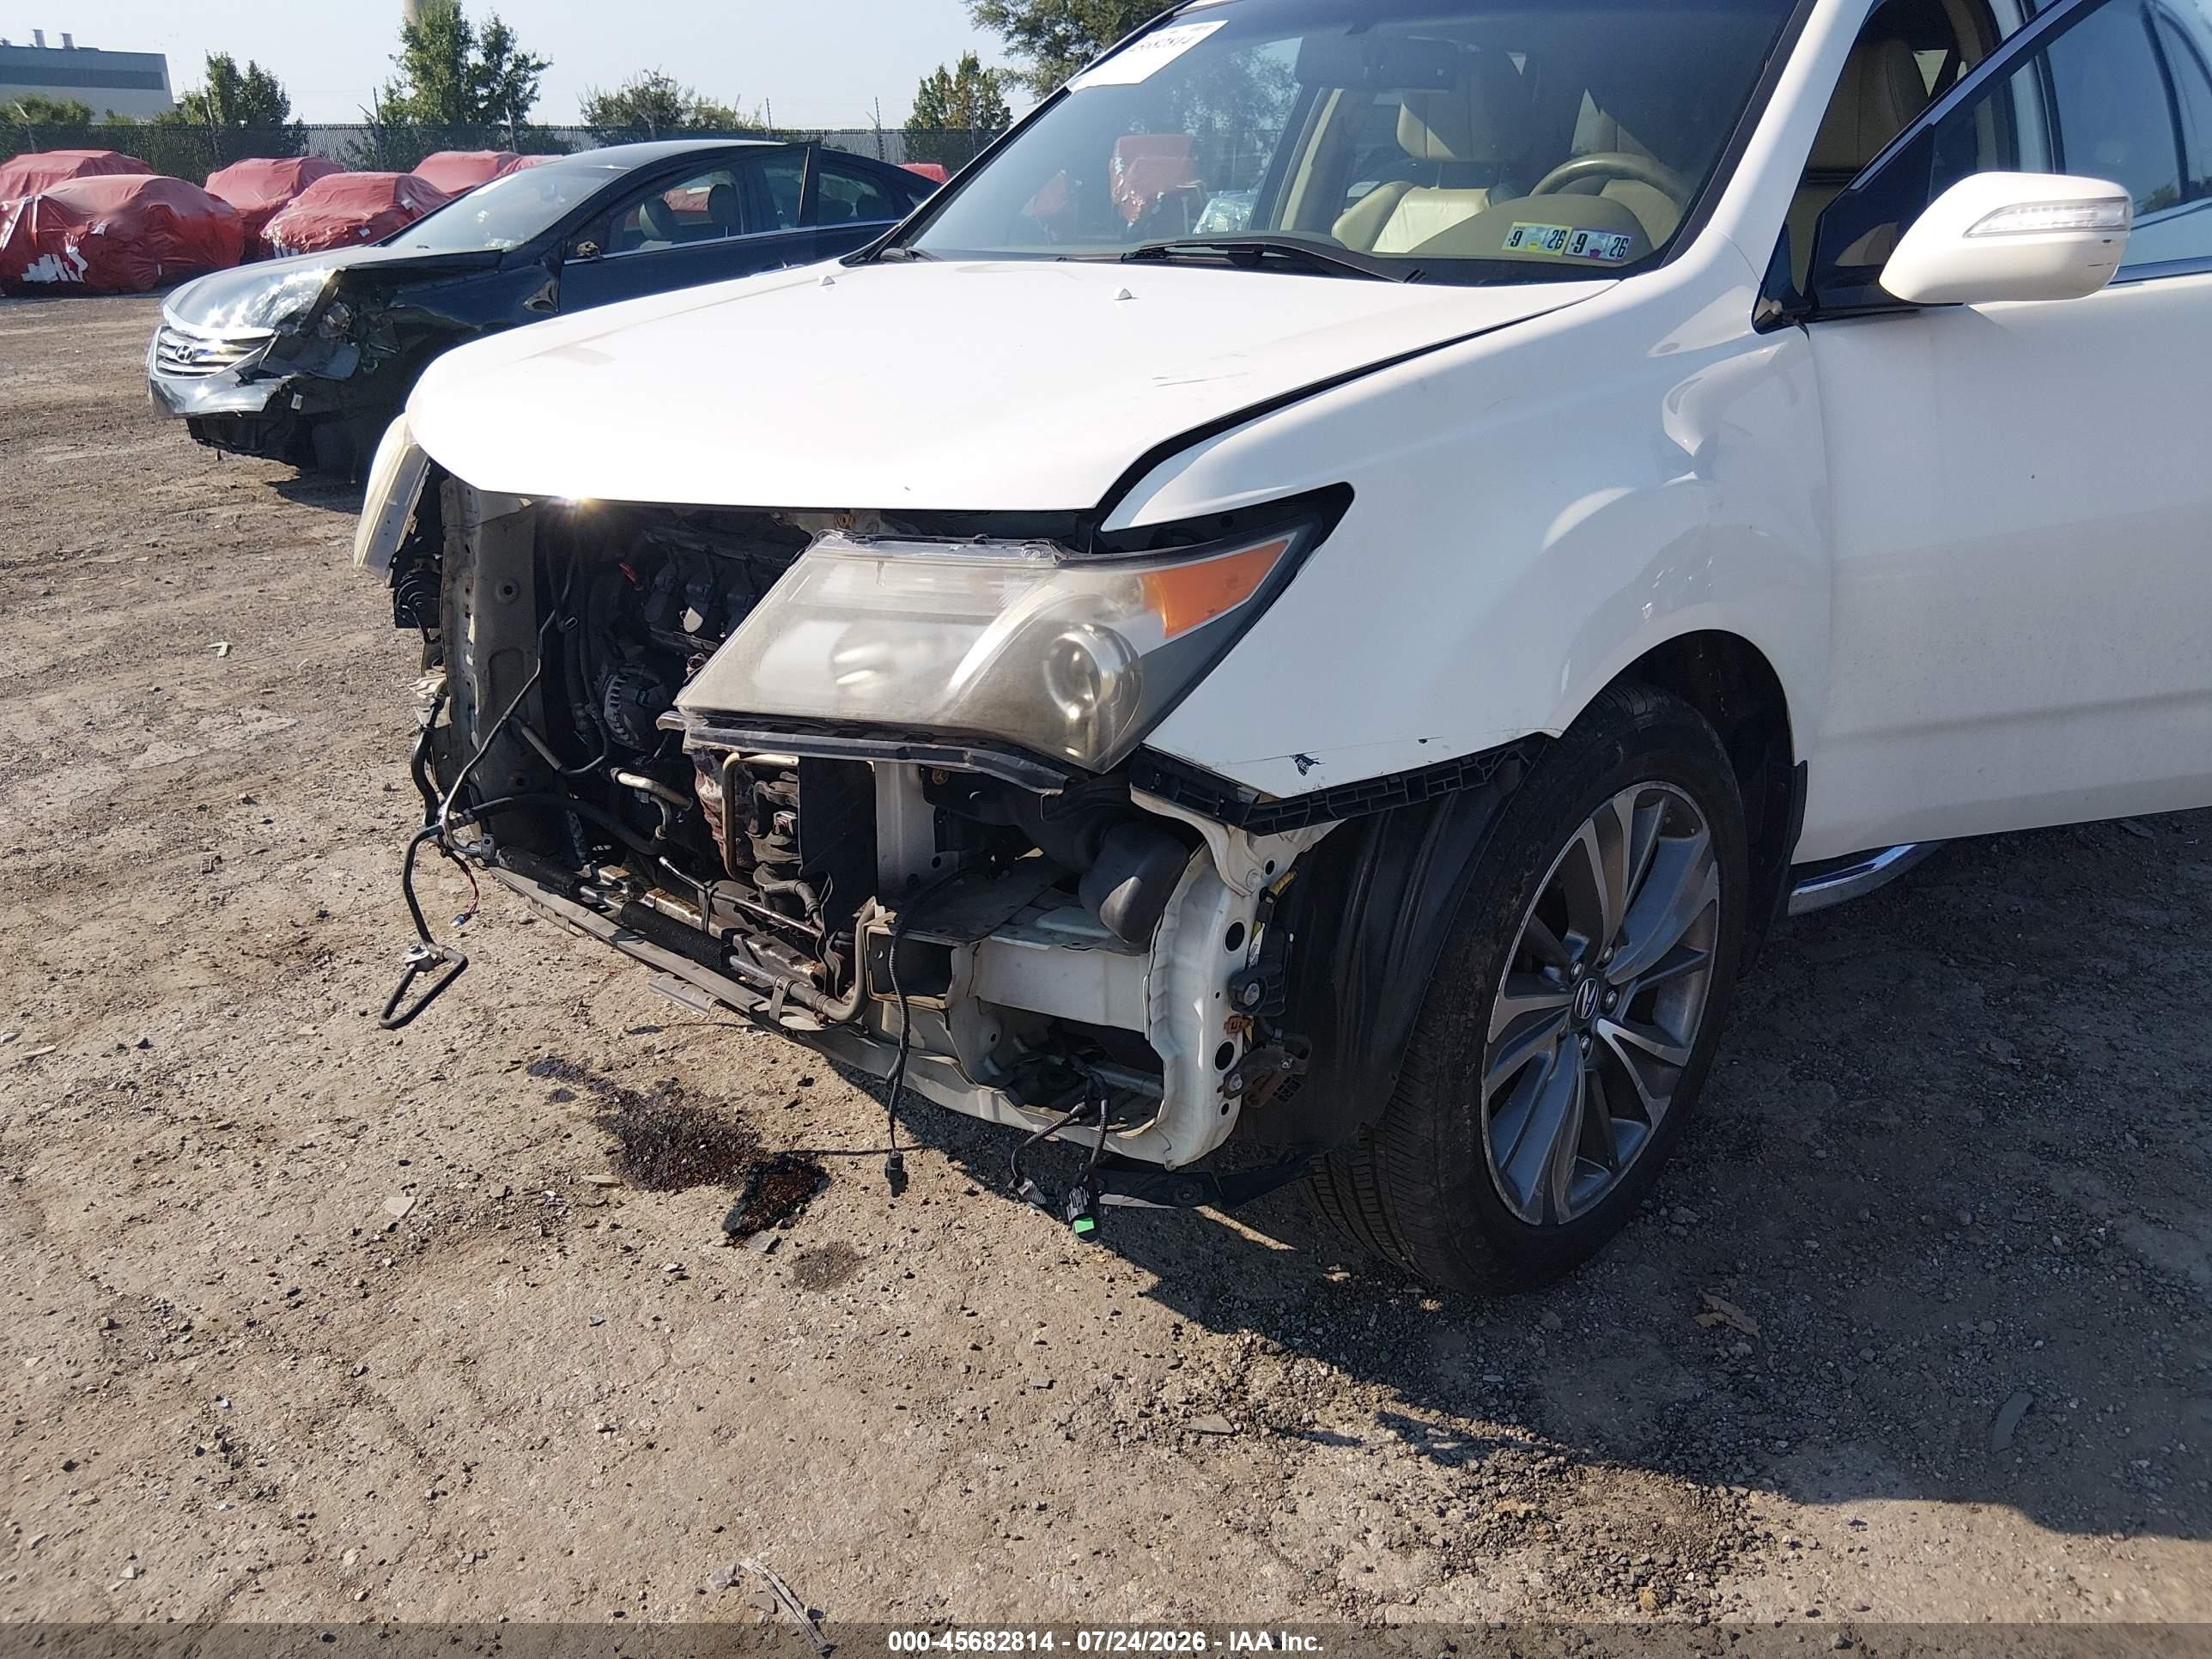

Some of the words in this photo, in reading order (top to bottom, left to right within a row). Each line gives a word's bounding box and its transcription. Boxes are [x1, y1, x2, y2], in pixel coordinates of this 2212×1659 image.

[1510, 230, 1523, 247] 9
[1546, 229, 1567, 250] 26
[1572, 233, 1589, 254] 9
[1608, 236, 1629, 258] 26
